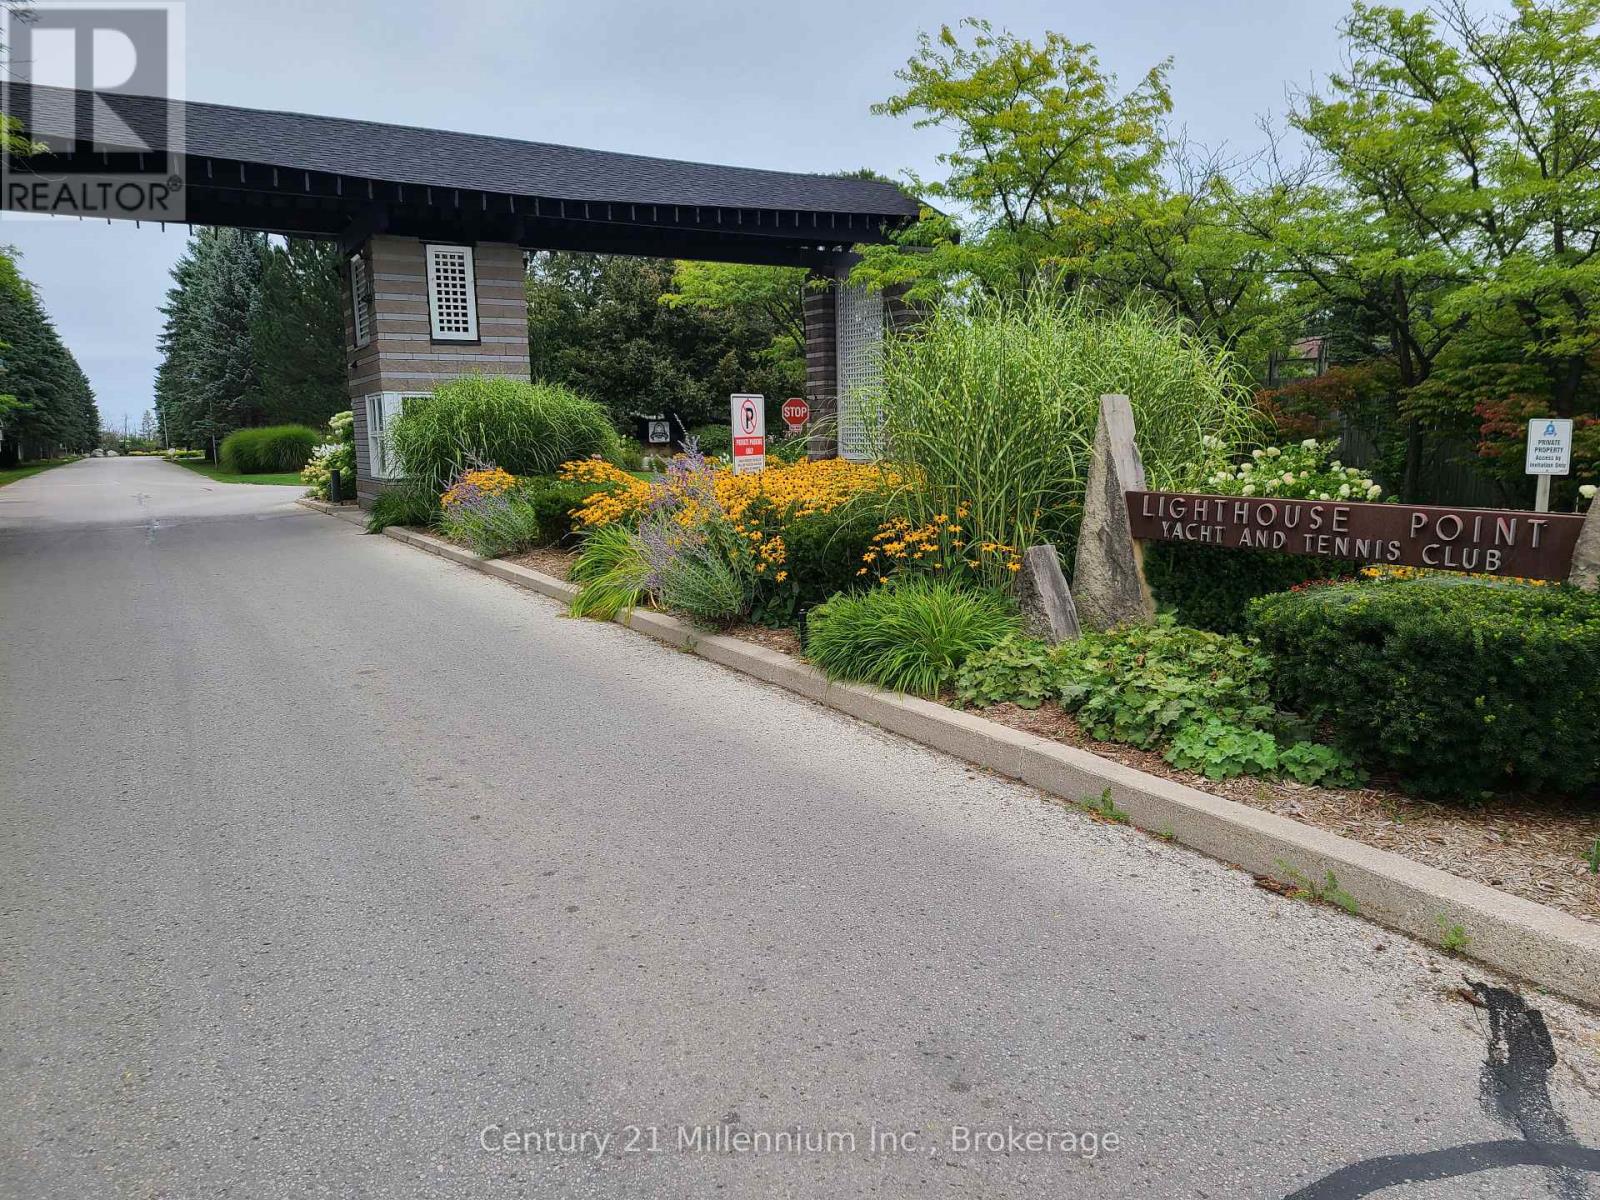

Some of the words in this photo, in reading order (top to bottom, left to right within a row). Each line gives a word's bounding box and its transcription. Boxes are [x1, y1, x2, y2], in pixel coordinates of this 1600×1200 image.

[784, 407, 807, 417] STOP
[1142, 495, 1350, 533] LIGHTHOUSE
[1410, 512, 1549, 548] POINT
[1161, 521, 1226, 544] YACHT
[1238, 527, 1288, 550] AND
[1303, 533, 1401, 561] TENNIS
[1422, 543, 1502, 571] CLUB
